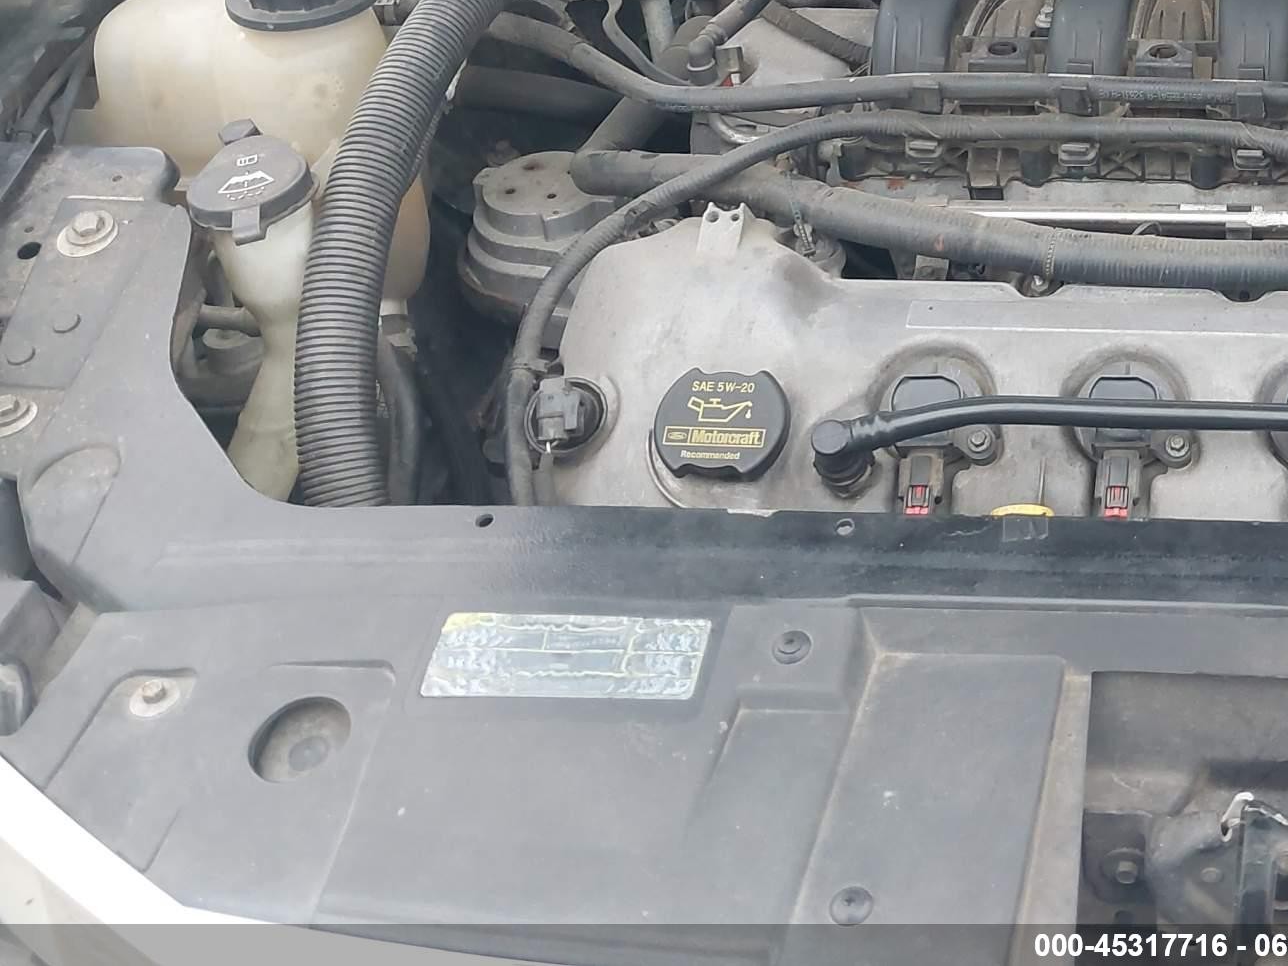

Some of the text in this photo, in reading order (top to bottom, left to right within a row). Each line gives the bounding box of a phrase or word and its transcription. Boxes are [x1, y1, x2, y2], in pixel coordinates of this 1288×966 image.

[692, 381, 755, 393] SAE 5W-20
[691, 429, 761, 445] Motorcraft
[680, 449, 741, 460] Recommended
